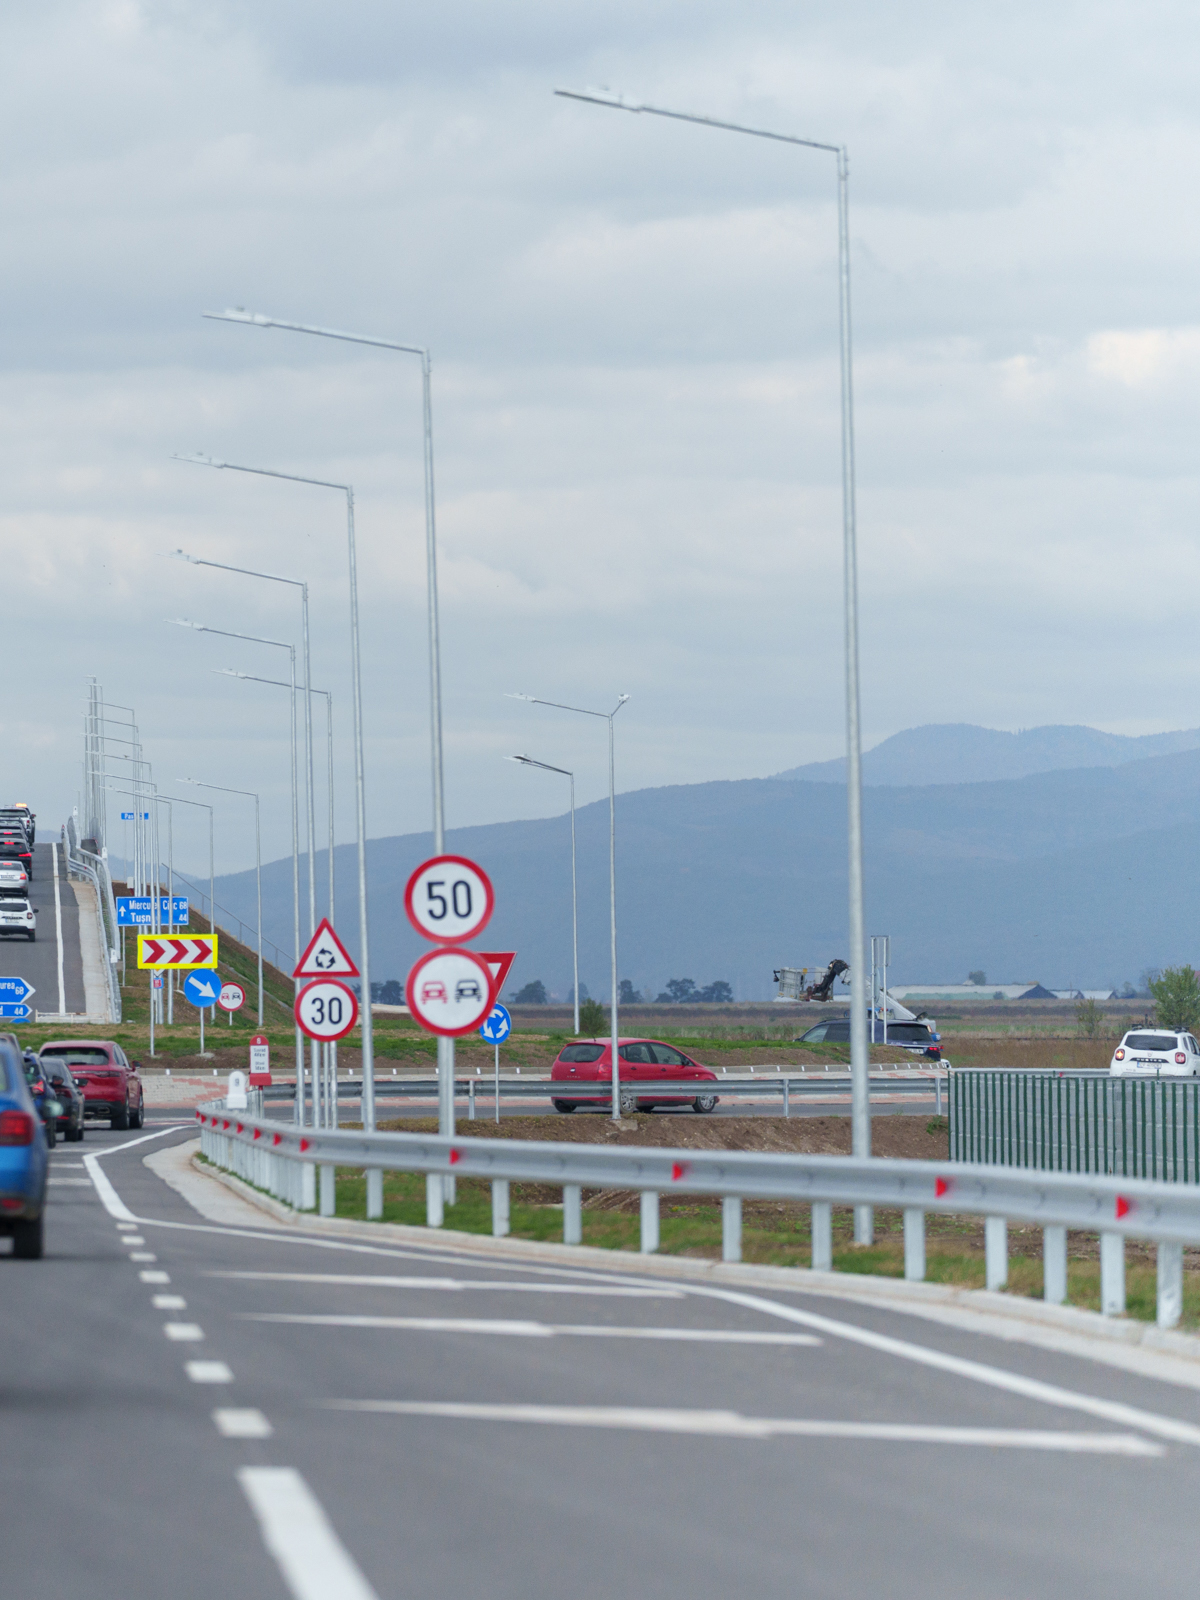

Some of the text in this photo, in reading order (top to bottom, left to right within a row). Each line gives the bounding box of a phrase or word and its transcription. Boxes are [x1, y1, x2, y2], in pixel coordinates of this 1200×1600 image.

[427, 880, 472, 920] 50
[179, 902, 187, 910] 68
[15, 986, 24, 995] 68
[14, 1007, 23, 1015] 44
[311, 997, 342, 1025] 30
